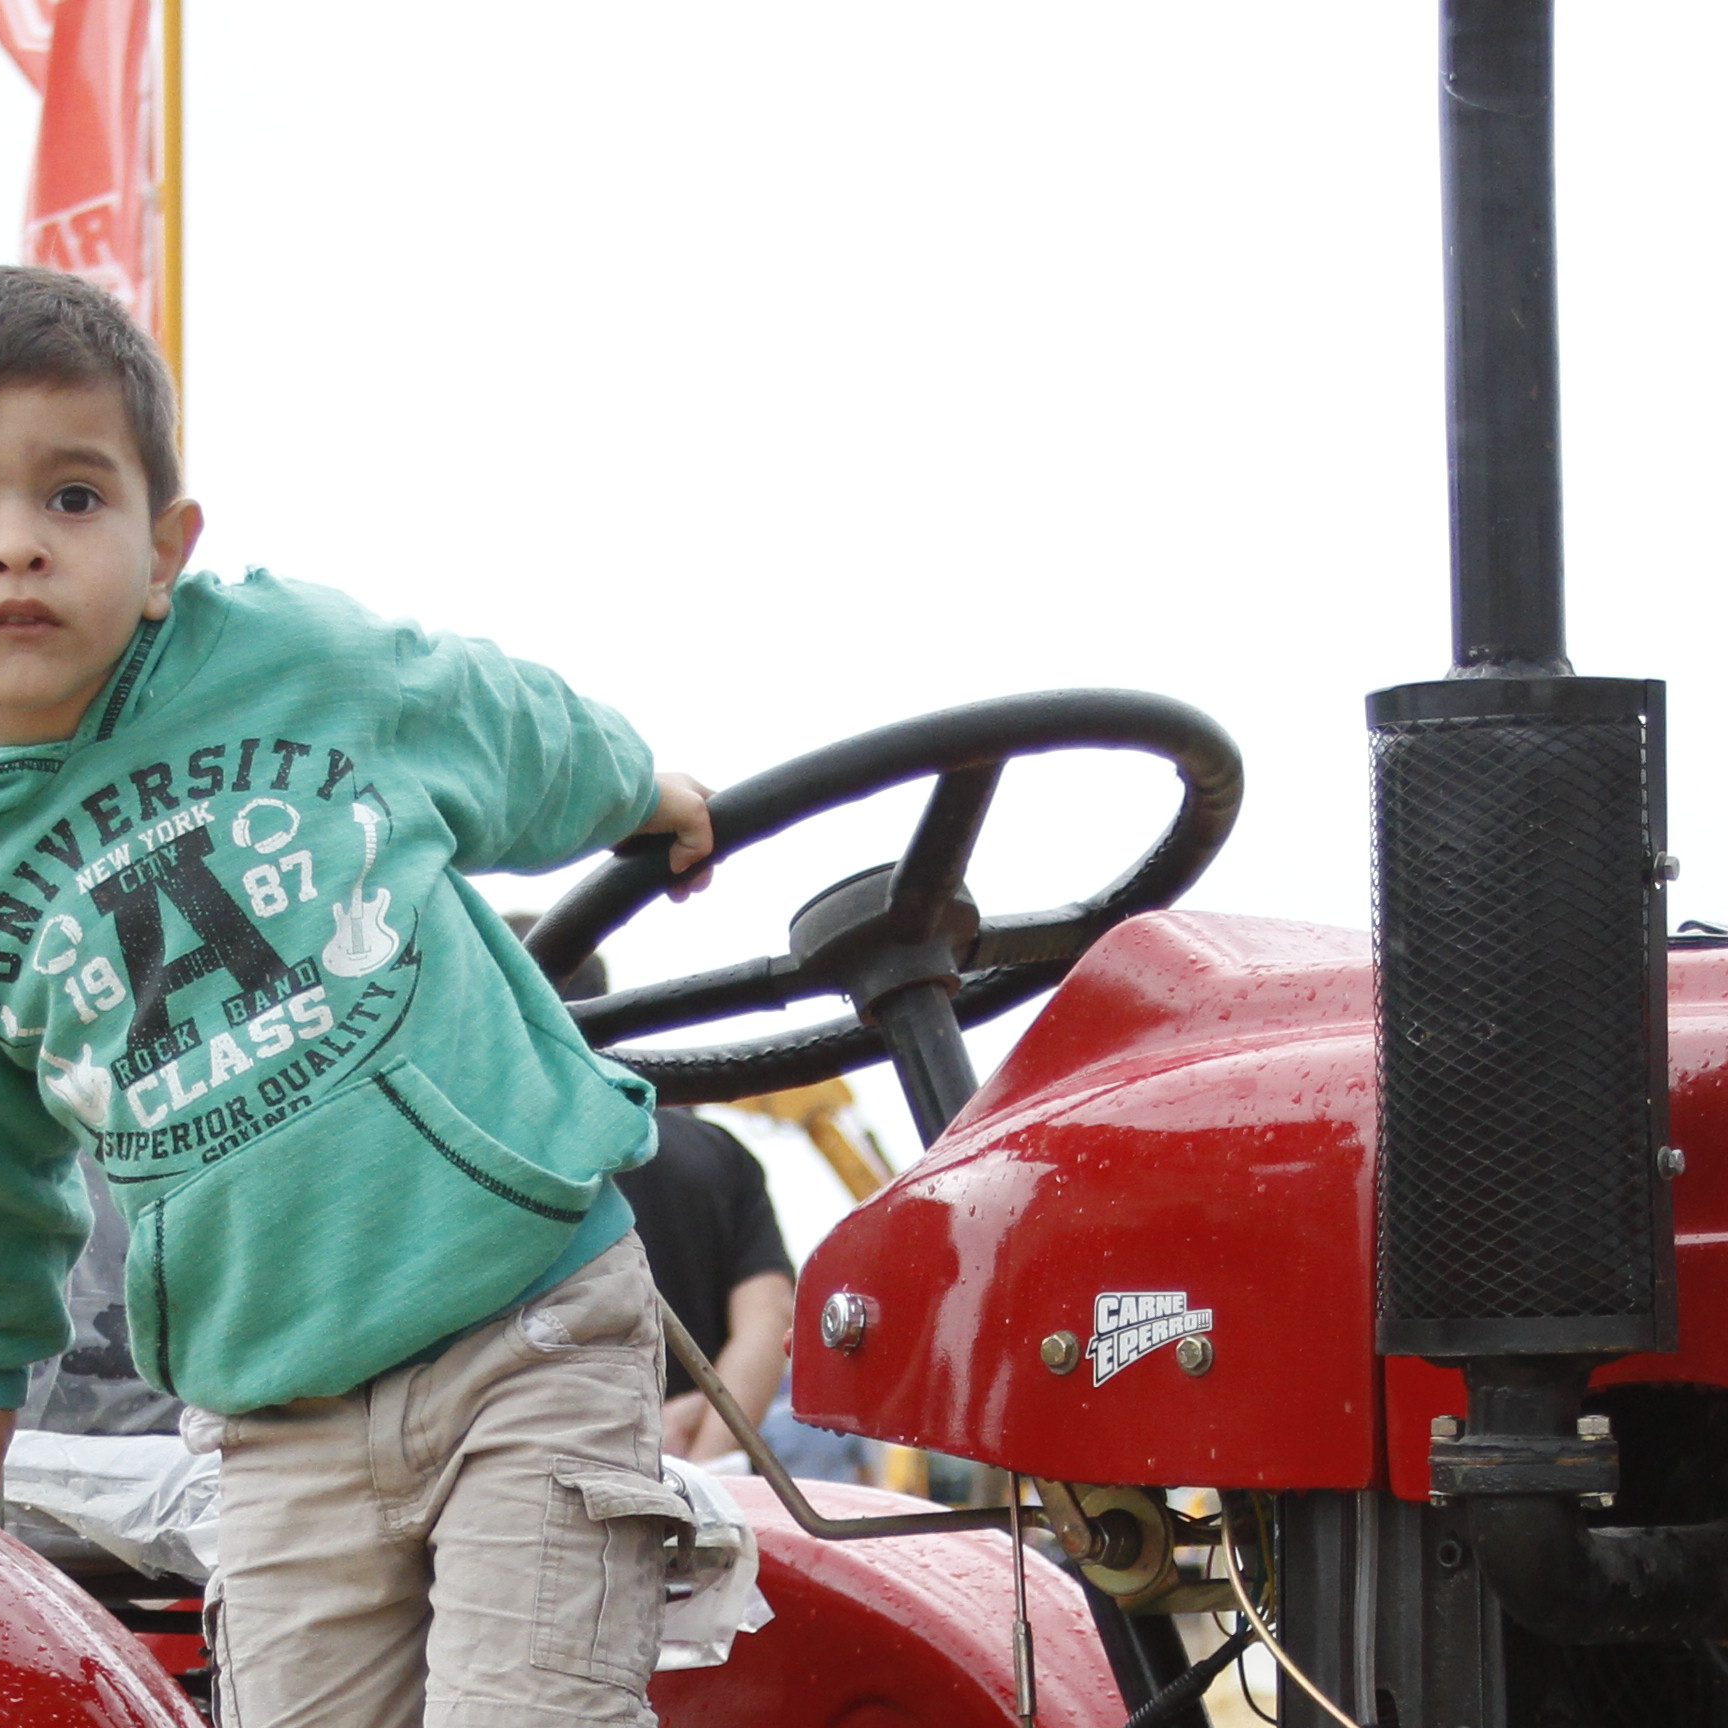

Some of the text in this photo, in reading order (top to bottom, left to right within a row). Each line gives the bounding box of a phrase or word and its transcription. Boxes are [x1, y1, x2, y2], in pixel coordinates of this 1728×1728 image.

[75, 801, 216, 895] NEW YORK
[118, 843, 180, 894] CITY
[242, 849, 318, 918] 87
[64, 955, 127, 1025] 19
[115, 1023, 196, 1085] ROCK
[227, 960, 318, 1024] BAND
[104, 981, 397, 1163] SUPERIOR QUALITY
[126, 985, 335, 1129] CLASS
[1096, 1294, 1184, 1335] CARNE
[1117, 1311, 1210, 1367] PERRO!!!
